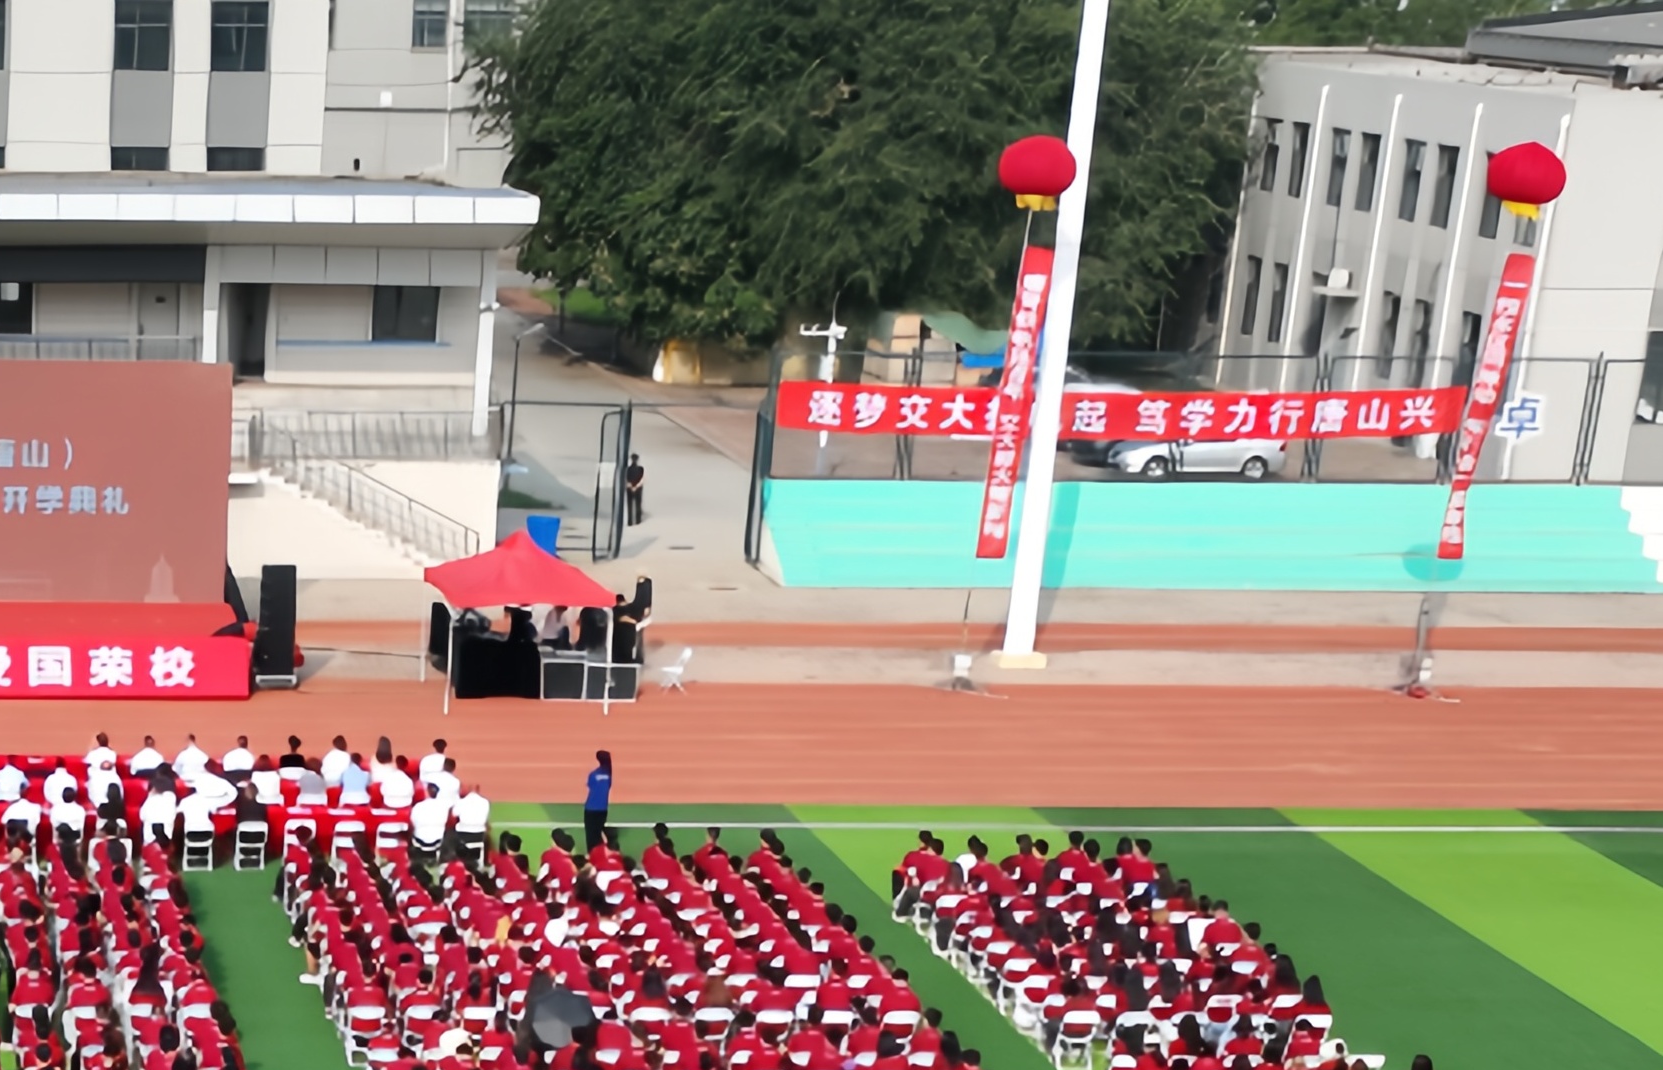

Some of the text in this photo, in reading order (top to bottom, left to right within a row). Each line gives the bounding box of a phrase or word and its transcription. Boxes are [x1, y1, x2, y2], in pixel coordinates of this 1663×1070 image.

[807, 390, 1437, 436] 逐梦交大起 笃学力行唐山兴
